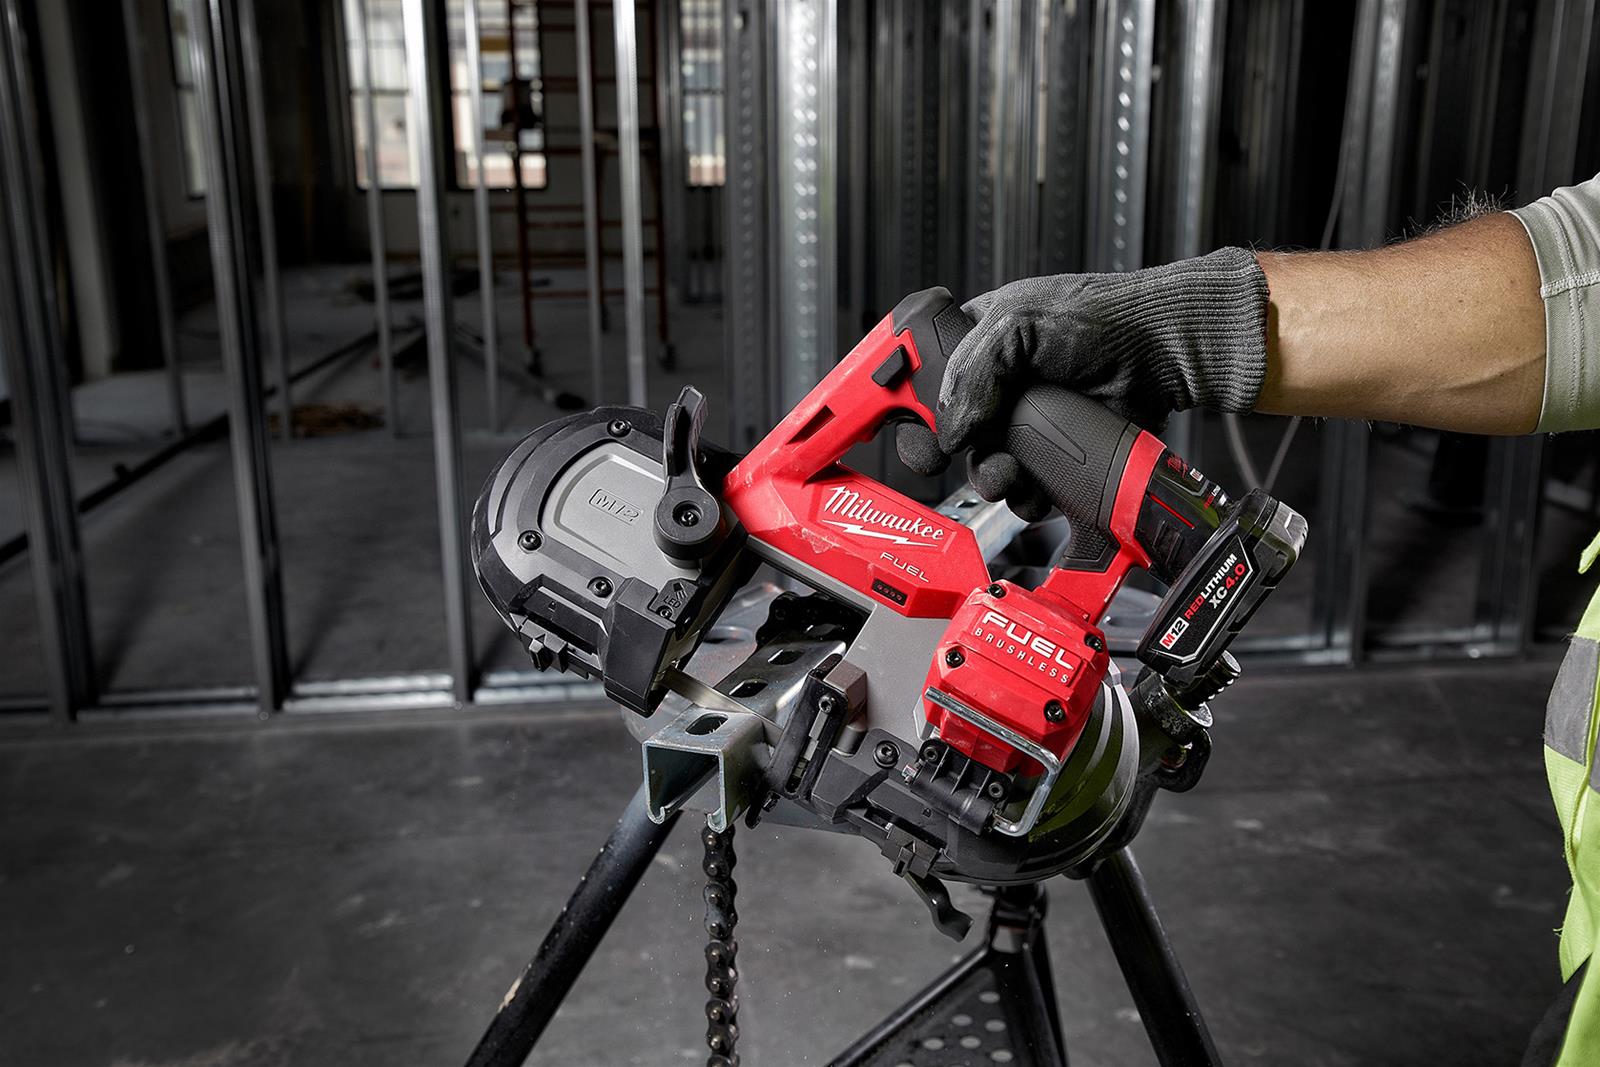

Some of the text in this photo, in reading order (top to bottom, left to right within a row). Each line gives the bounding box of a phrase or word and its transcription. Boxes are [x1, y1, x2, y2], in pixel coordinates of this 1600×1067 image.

[596, 495, 639, 523] M12
[824, 486, 944, 541] Milwaukee
[880, 552, 930, 583] FUEL
[663, 595, 683, 609] LED
[981, 611, 1074, 670] FUEL
[1161, 619, 1187, 648] M12
[974, 627, 1069, 683] BRUSHLESS
